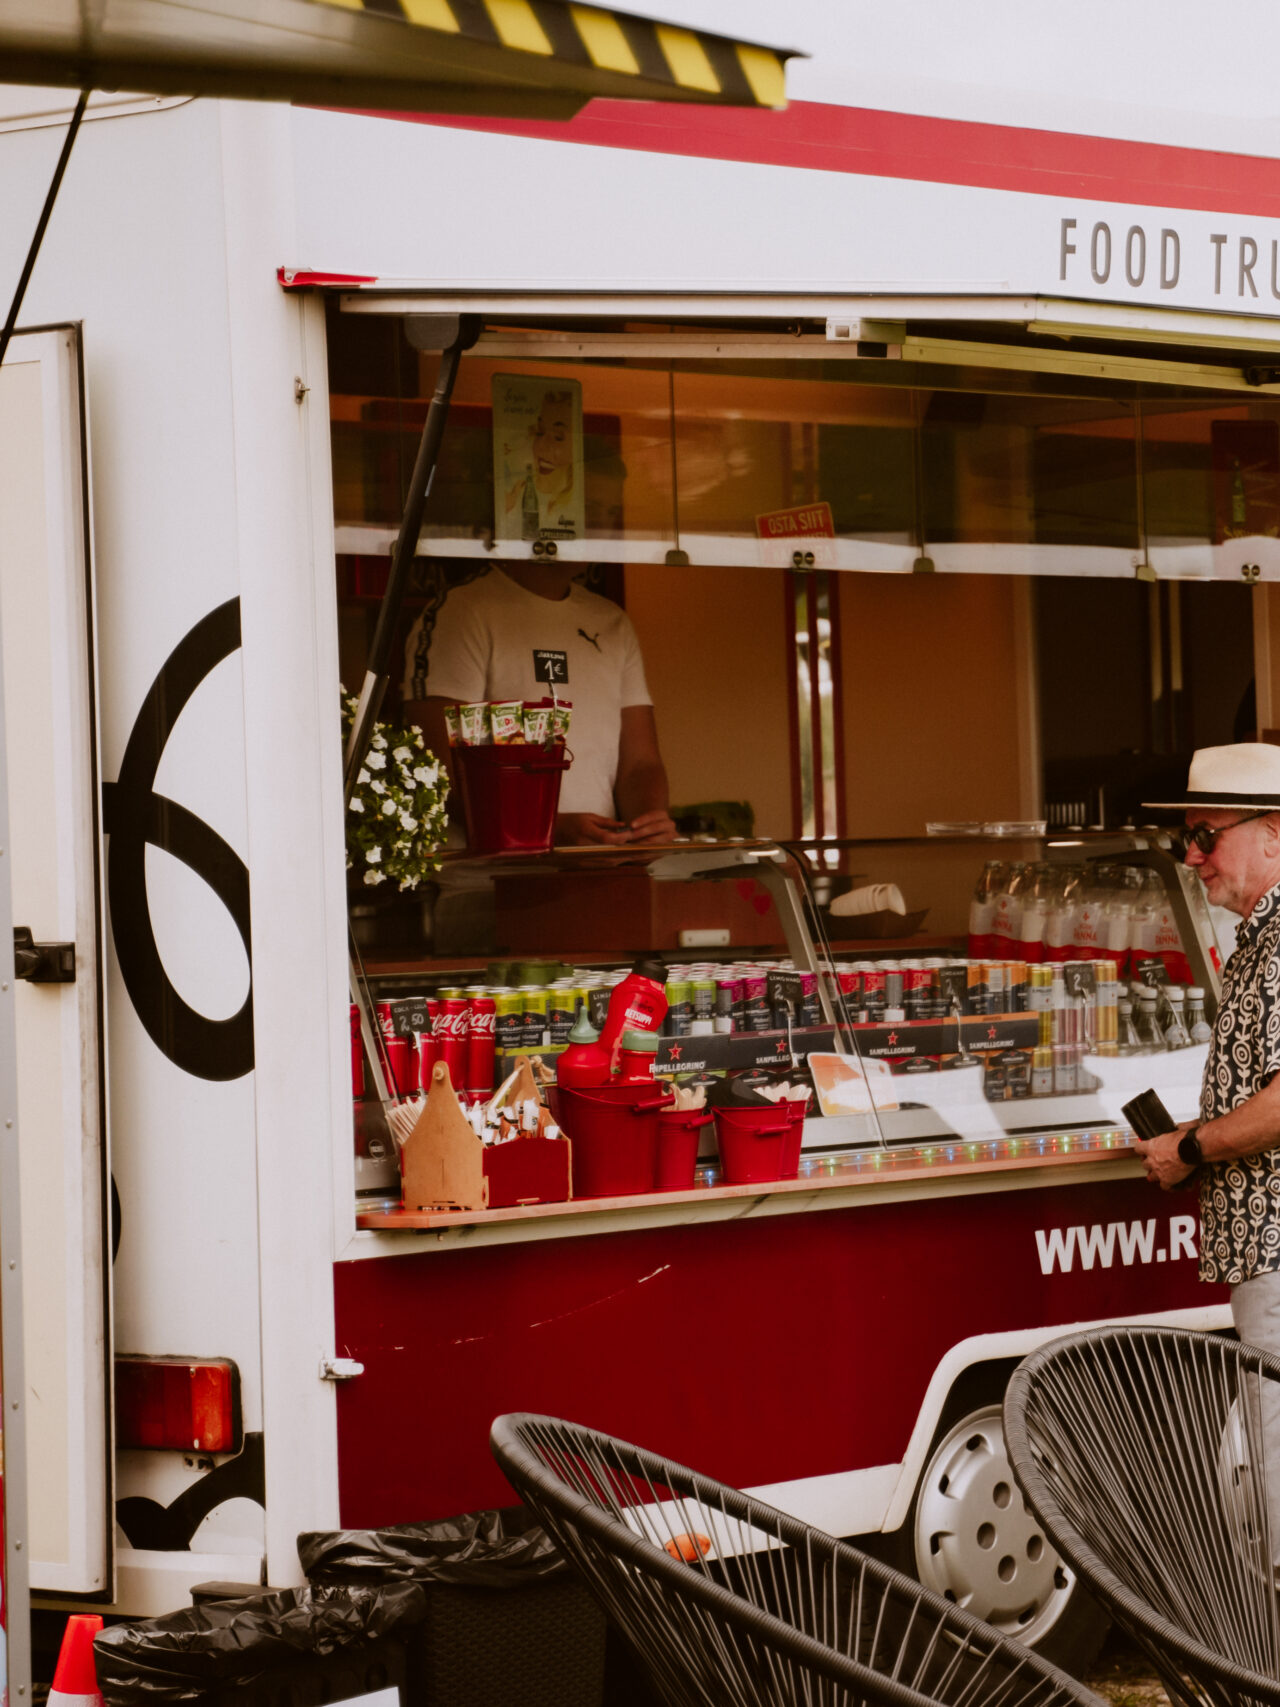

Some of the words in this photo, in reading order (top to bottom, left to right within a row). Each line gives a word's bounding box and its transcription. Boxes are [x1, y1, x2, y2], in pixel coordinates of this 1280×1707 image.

[1059, 217, 1181, 291] FOOD
[767, 515, 798, 535] OSTA
[798, 510, 825, 531] SIIT
[544, 659, 564, 680] 1€
